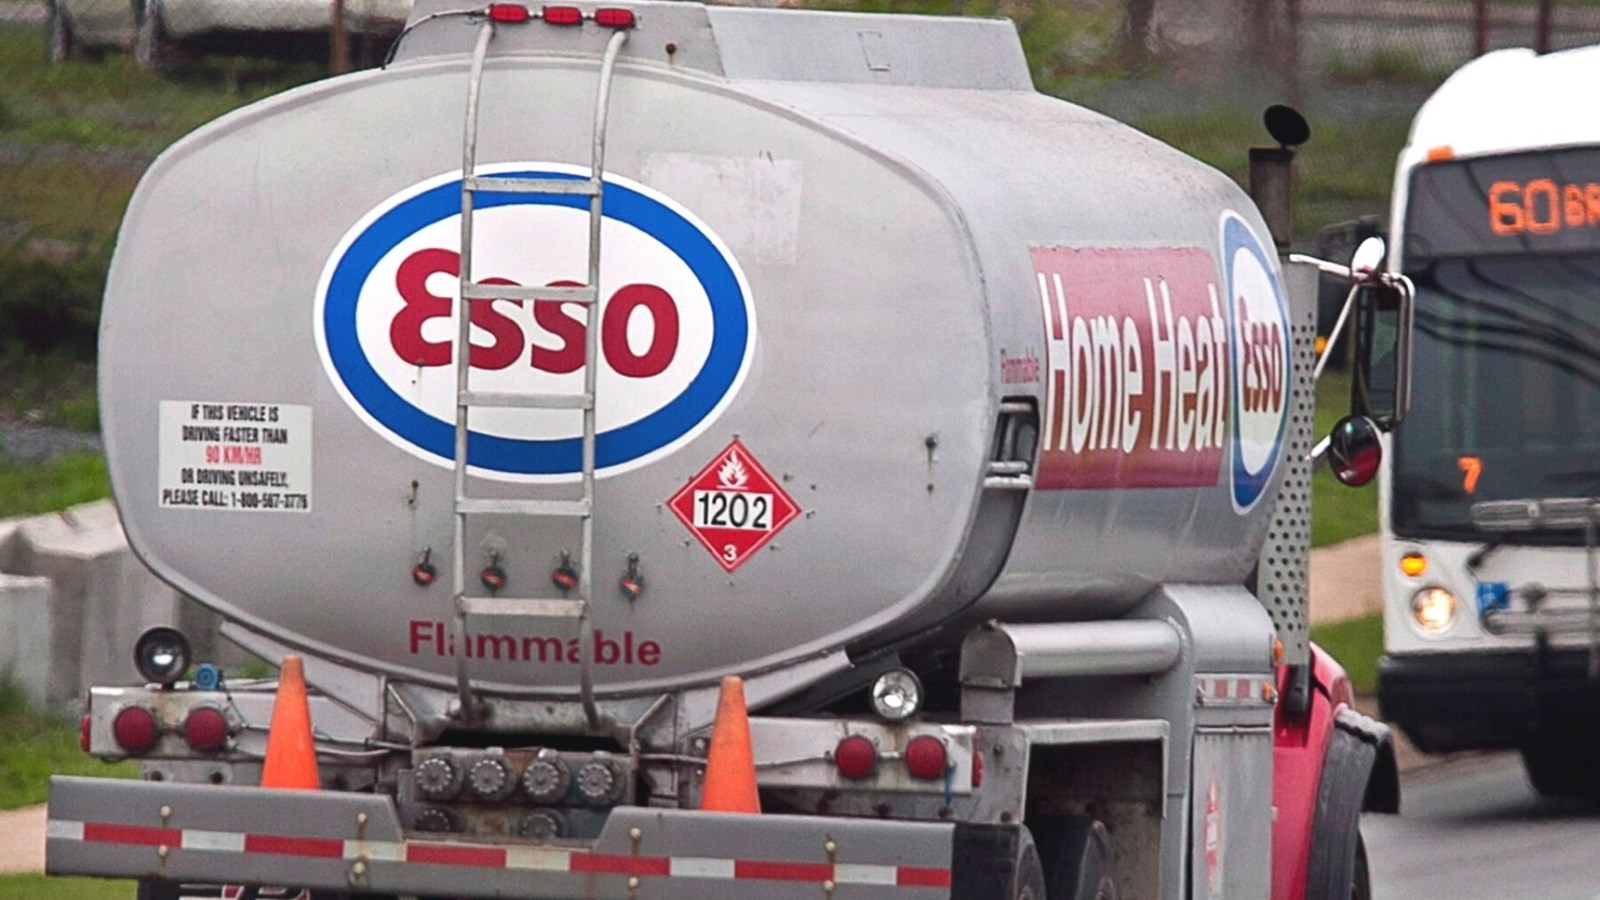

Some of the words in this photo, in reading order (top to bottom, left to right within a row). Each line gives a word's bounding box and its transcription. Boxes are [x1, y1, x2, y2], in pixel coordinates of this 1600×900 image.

[1488, 178, 1560, 235] 60
[1038, 272, 1143, 454] Home
[1143, 277, 1227, 453] Heat
[191, 404, 200, 420] IF
[202, 405, 224, 421] THIS
[226, 405, 266, 422] VEHICLE
[268, 406, 279, 423] IS
[182, 425, 221, 442] DRIVING
[223, 426, 259, 443] FASTER
[261, 428, 288, 444] THAN
[223, 446, 263, 465] KM/HR
[181, 468, 195, 484] OR
[196, 469, 236, 486] DRIVING
[1457, 456, 1483, 492] 7
[162, 489, 199, 506] PLEASE
[698, 492, 767, 529] 1202
[723, 544, 737, 561] 3
